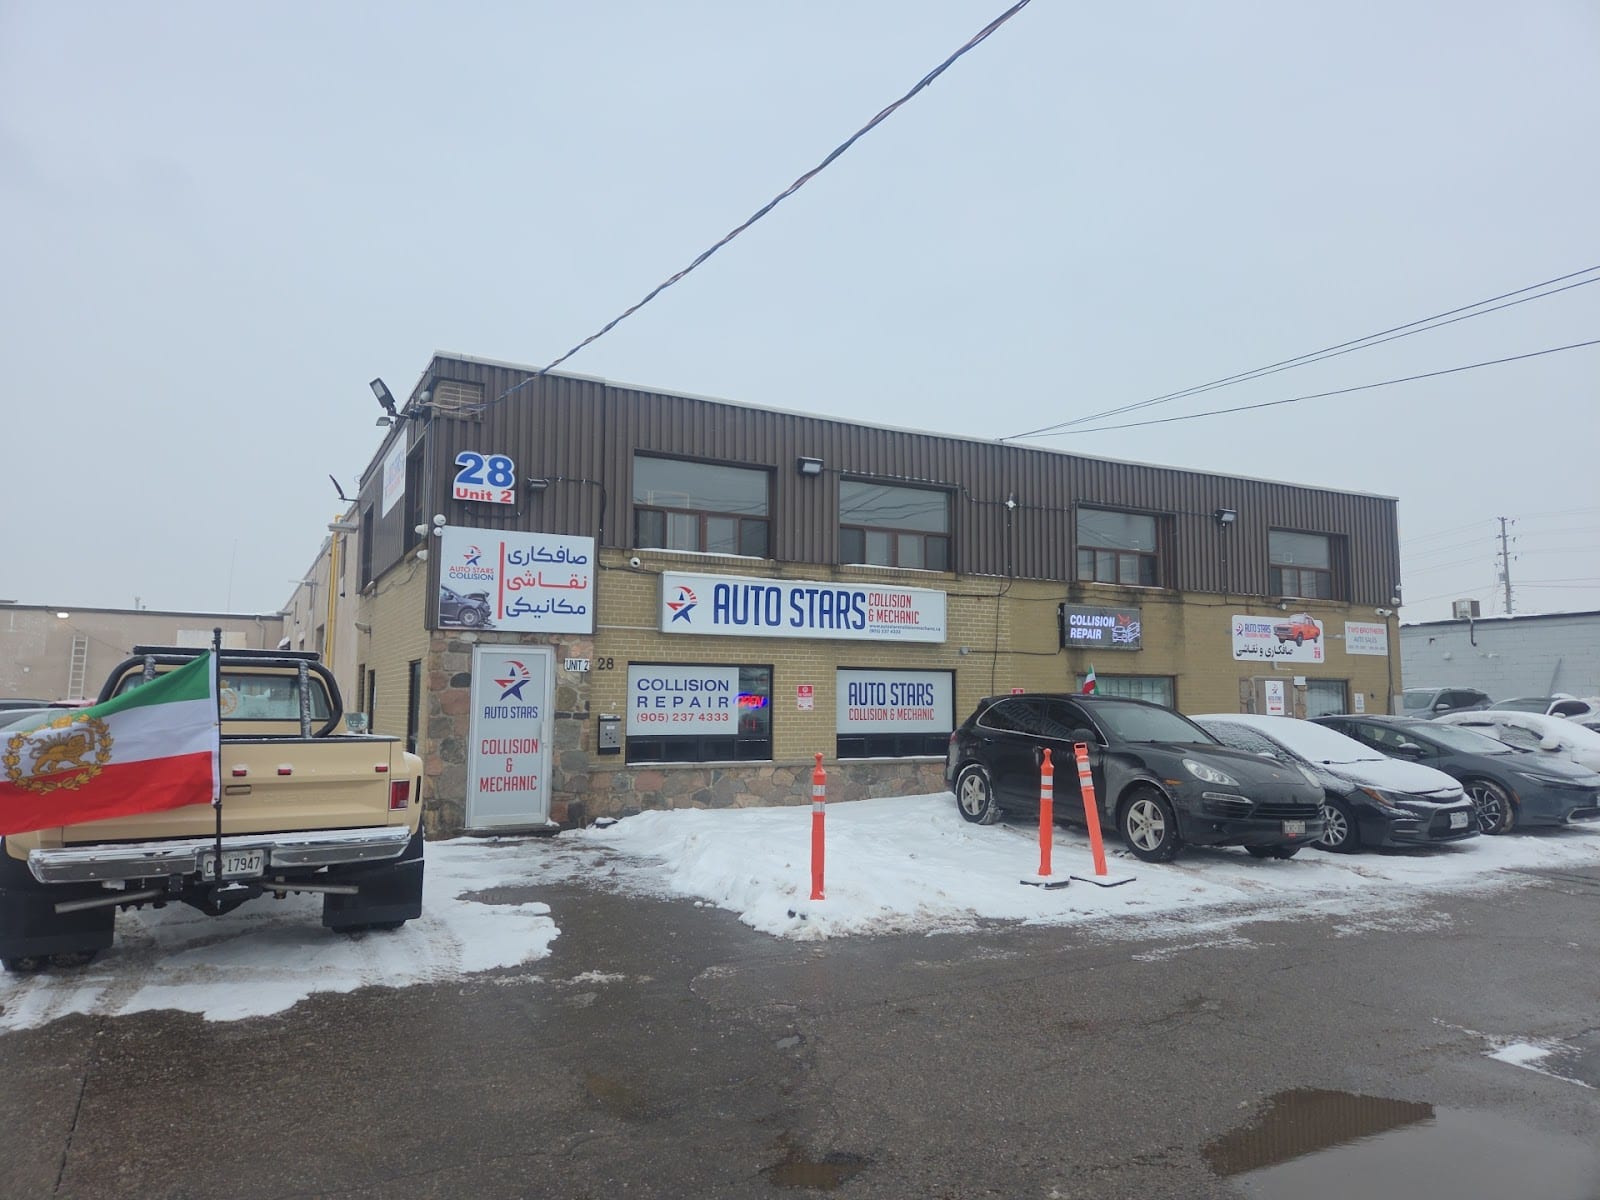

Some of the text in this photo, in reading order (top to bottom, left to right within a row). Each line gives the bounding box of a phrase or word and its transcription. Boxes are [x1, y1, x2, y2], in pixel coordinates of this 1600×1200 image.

[456, 452, 513, 487] 28
[455, 487, 512, 502] Unit 2
[507, 545, 588, 566] صافکاری
[449, 566, 471, 574] AUTO
[449, 572, 494, 581] COLLISION
[505, 596, 586, 618] مکانیکی
[713, 583, 866, 630] AUTO STARS
[868, 592, 912, 609] COLLISION
[868, 609, 920, 624] & MECHANIC
[1070, 614, 1115, 627] COLLISION
[1070, 627, 1102, 640] REPAIR
[566, 659, 589, 671] UNIT 2
[598, 658, 614, 670] 28
[637, 678, 729, 692] COLLISION
[849, 682, 934, 706] AUTO STARS
[637, 696, 729, 708] REPAIR
[736, 695, 765, 708] OPEN
[484, 706, 538, 719] AUTO STARS
[636, 713, 729, 723] (905) 237 4333
[849, 708, 934, 721] COLLISION & MECHANIC
[481, 738, 538, 755] COLLISION
[505, 757, 513, 773] &
[479, 775, 537, 793] MECHANIC
[227, 856, 260, 872] 17947
